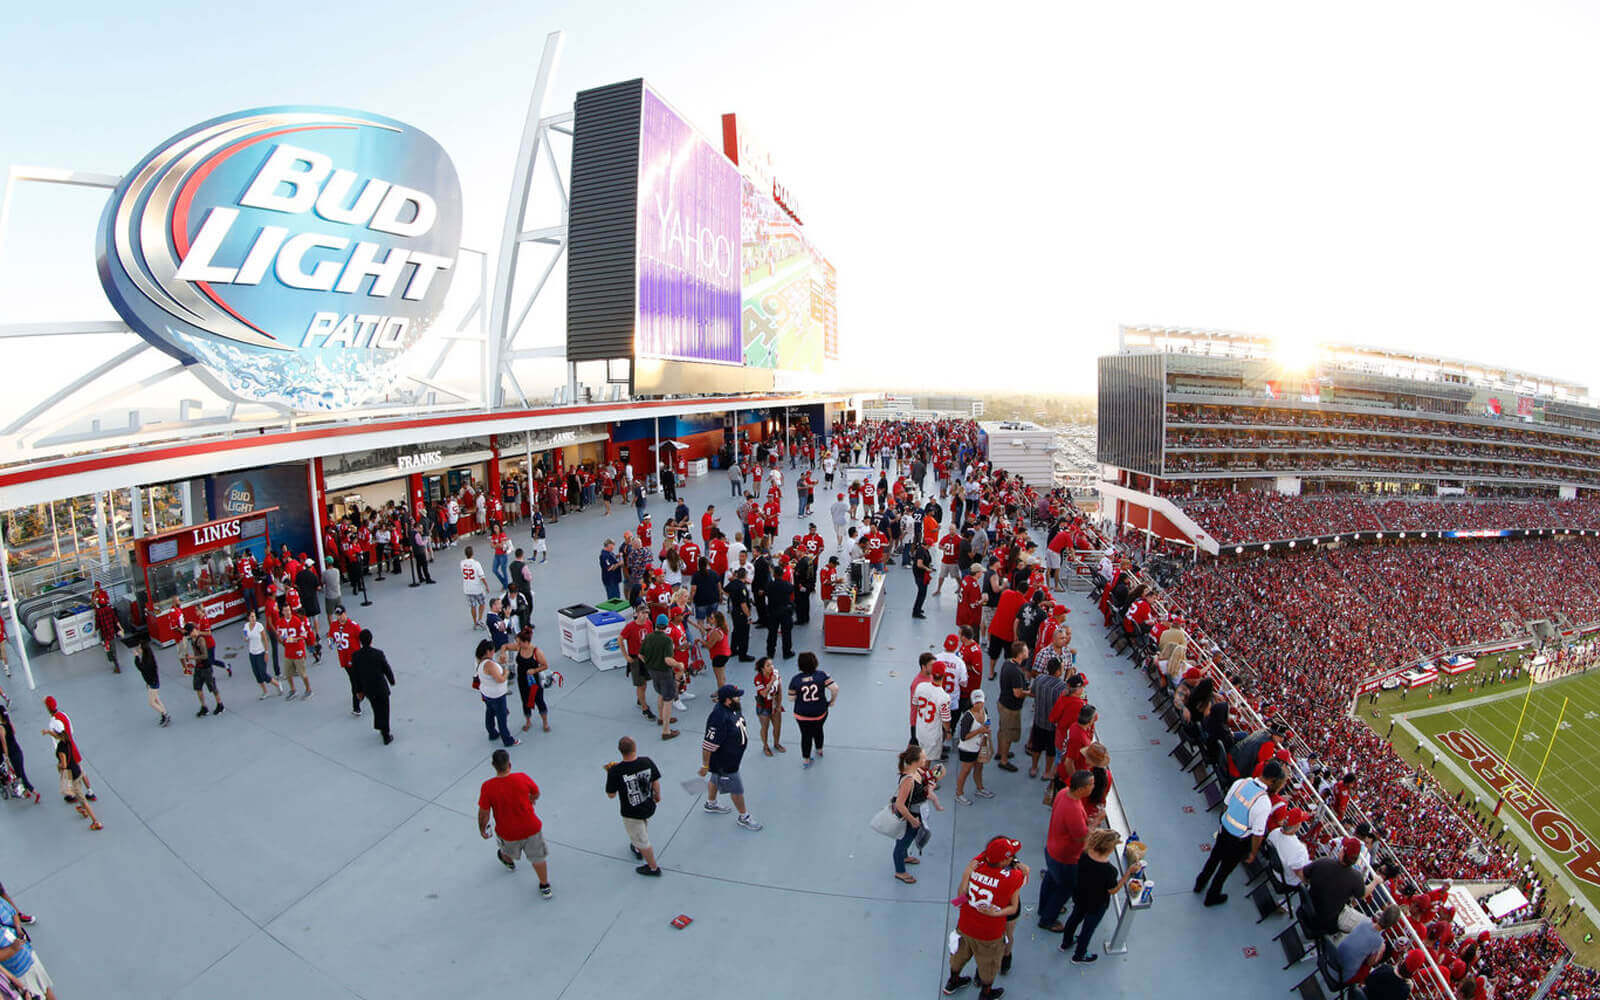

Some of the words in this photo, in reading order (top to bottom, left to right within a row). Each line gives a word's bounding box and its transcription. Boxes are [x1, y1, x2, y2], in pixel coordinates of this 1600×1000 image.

[237, 144, 438, 240] BUD
[655, 191, 735, 279] YAHOO!
[173, 206, 454, 301] LIGHT
[301, 312, 410, 349] PATIO
[397, 450, 442, 472] FRANKS
[228, 500, 254, 513] LIGHT
[231, 489, 251, 502] BUD
[193, 520, 241, 547] LINKS
[463, 568, 476, 580] 52
[801, 683, 820, 702] 22
[918, 696, 937, 723] 23
[968, 881, 1001, 909] 52
